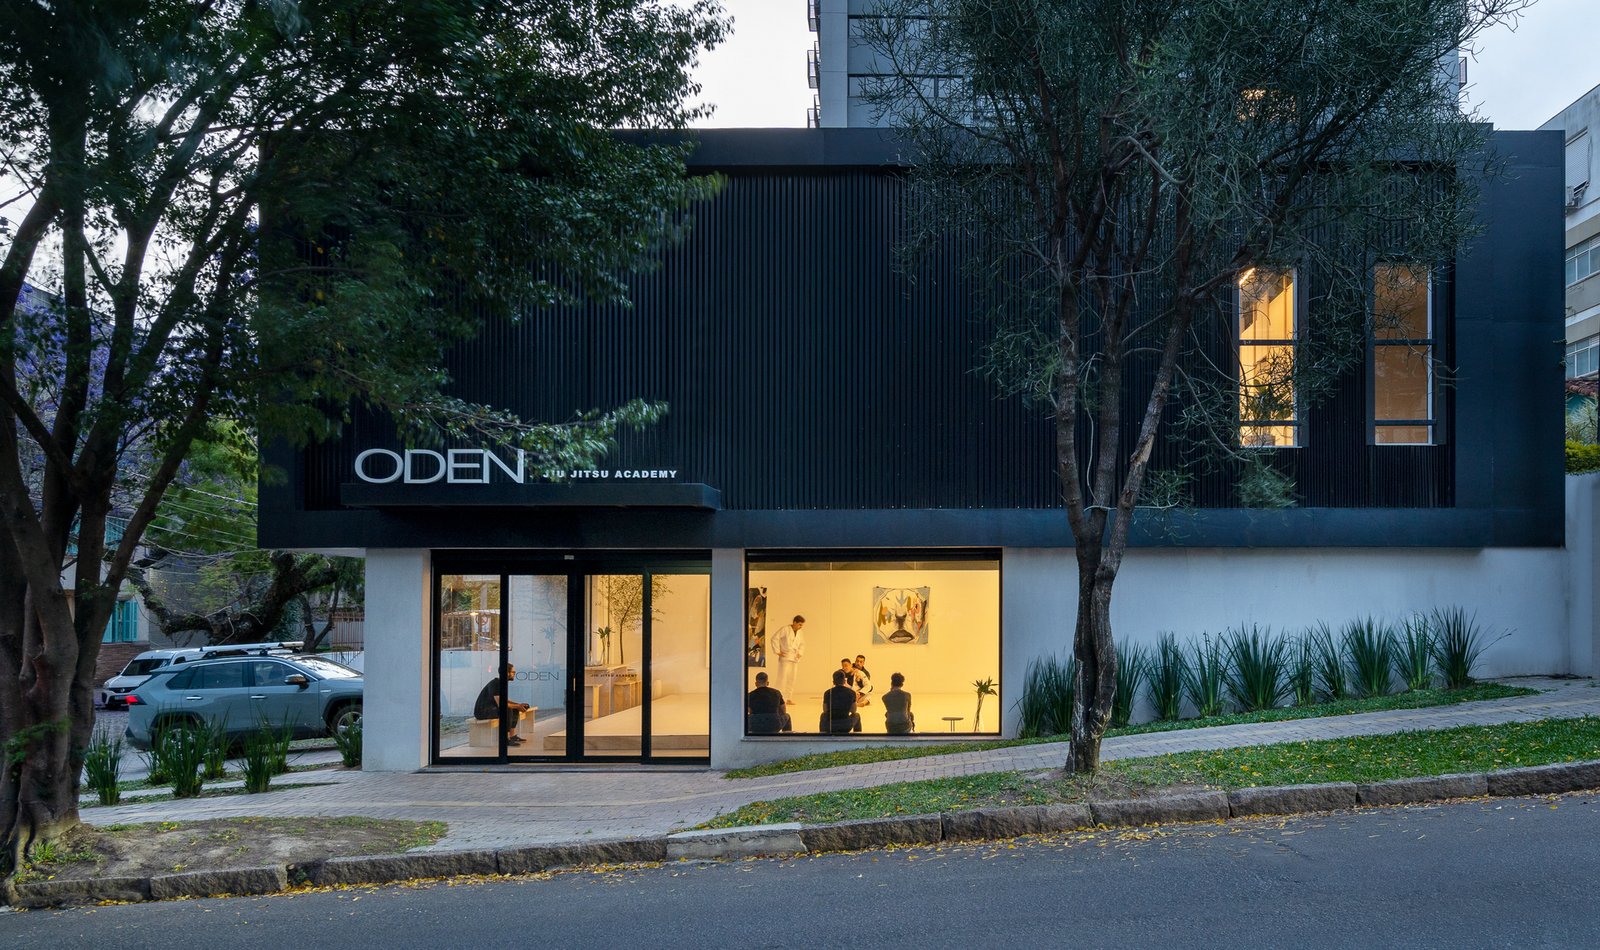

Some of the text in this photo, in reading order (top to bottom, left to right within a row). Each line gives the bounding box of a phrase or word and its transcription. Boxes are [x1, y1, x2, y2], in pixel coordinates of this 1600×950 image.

[354, 448, 525, 484] ODEN
[542, 470, 677, 479] JIU JITSU ACADEMY
[515, 671, 559, 681] ODEN
